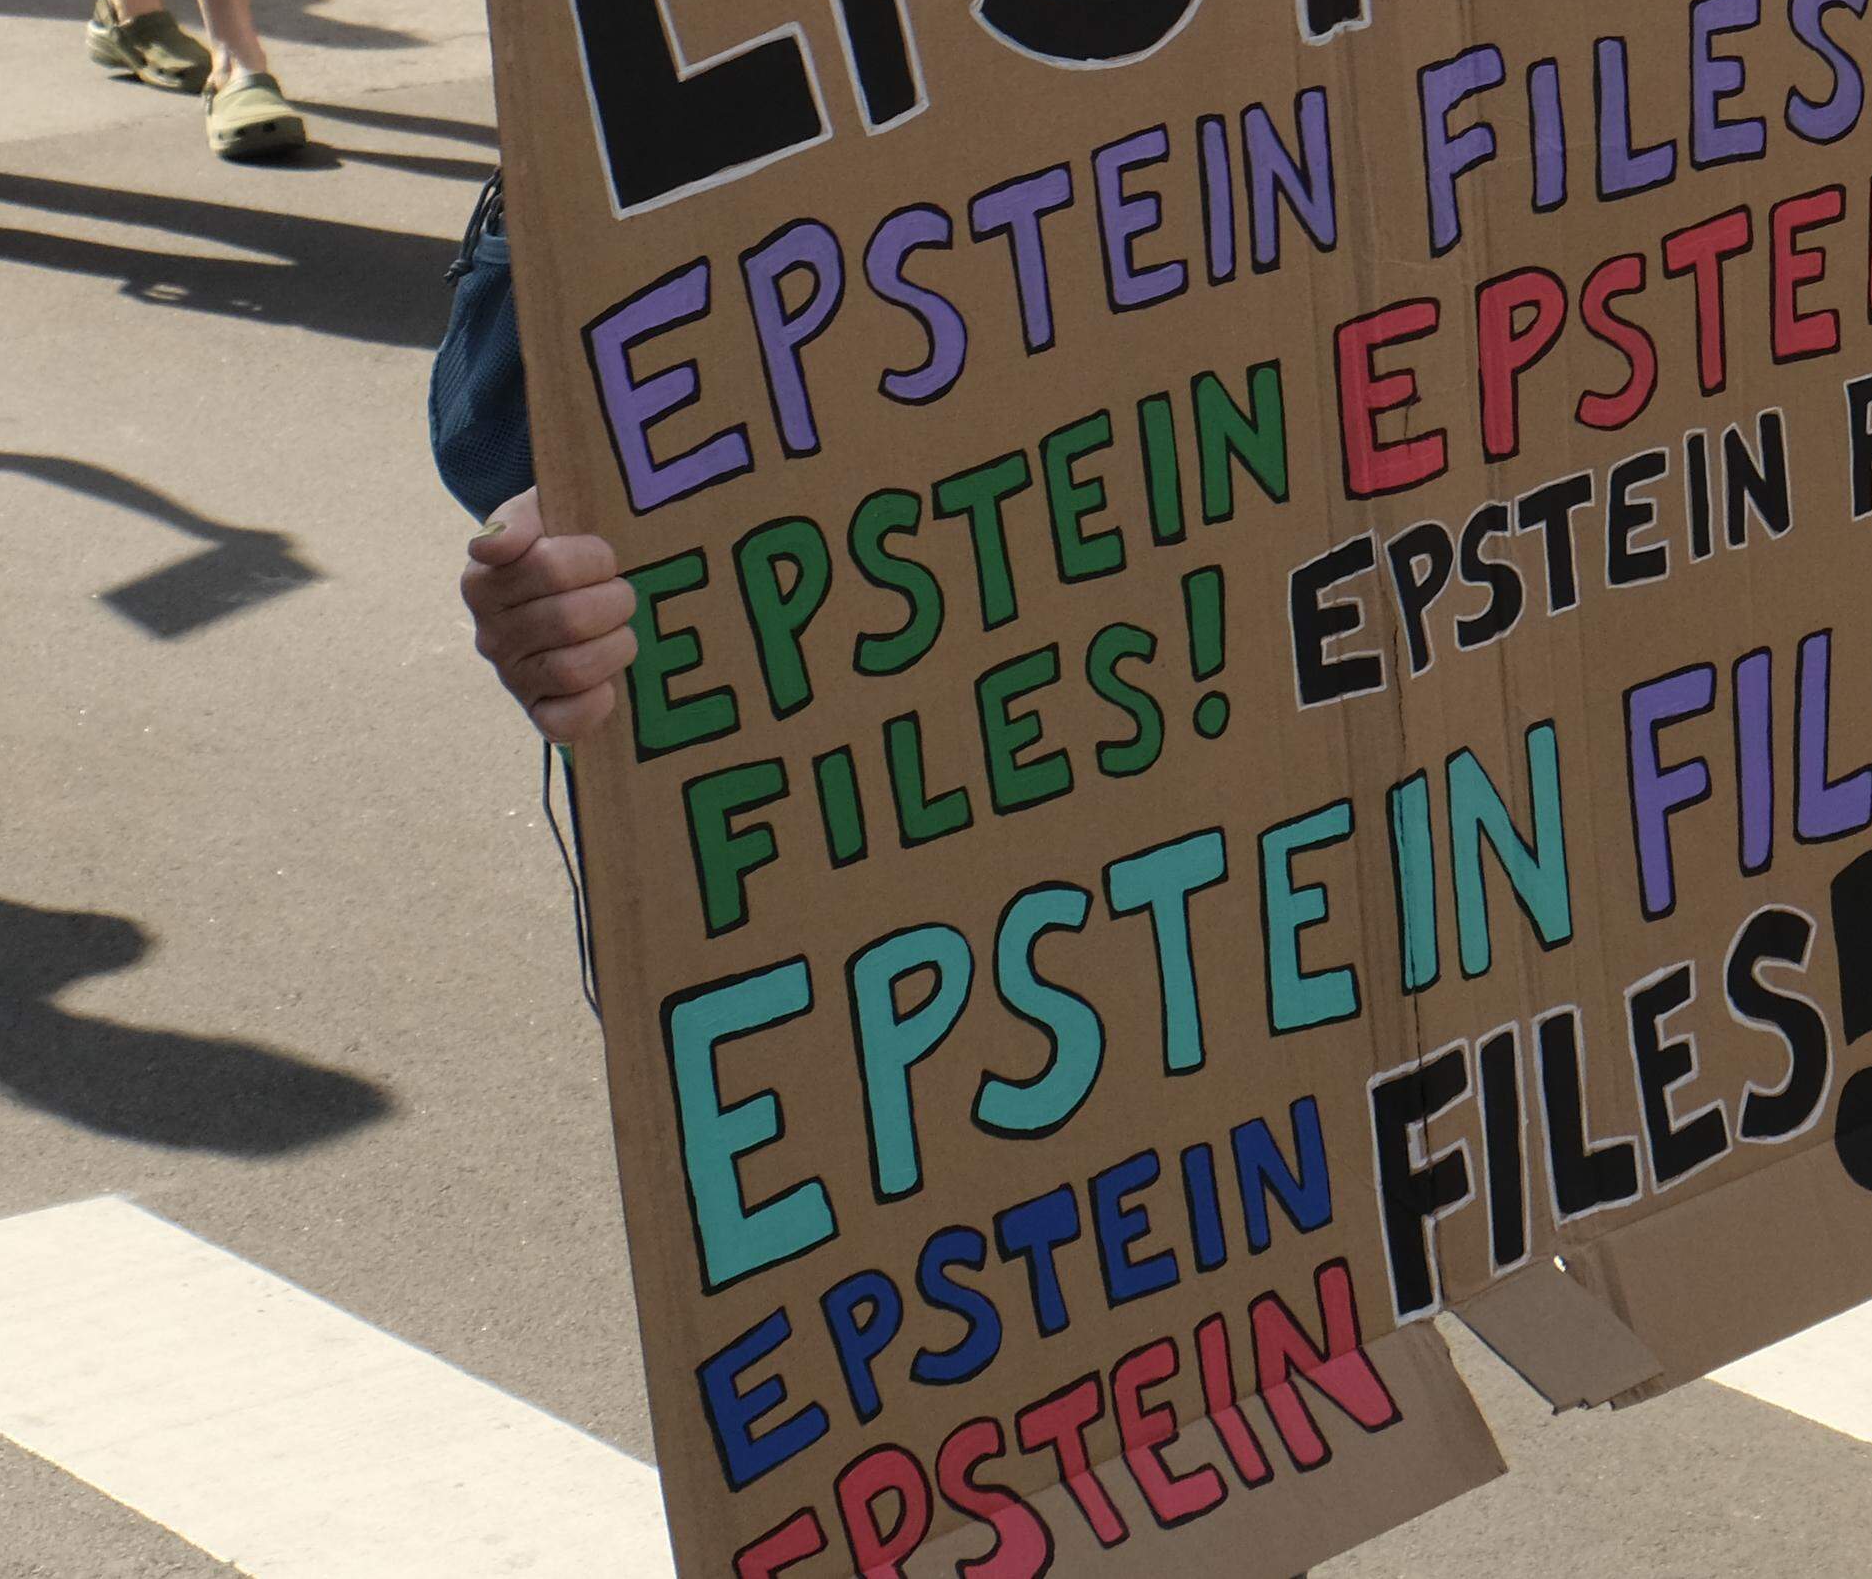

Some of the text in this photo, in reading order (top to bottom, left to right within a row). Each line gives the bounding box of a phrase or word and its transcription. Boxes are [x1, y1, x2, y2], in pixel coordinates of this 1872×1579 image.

[581, 86, 1337, 515] EPSTEIN
[621, 358, 1289, 763] EPSTEIN
[682, 564, 1231, 939] FILES!
[1287, 407, 1795, 710] EPSTEIN
[659, 719, 1573, 1295] EPSTEIN
[693, 1094, 1334, 1493] EPSTEIN
